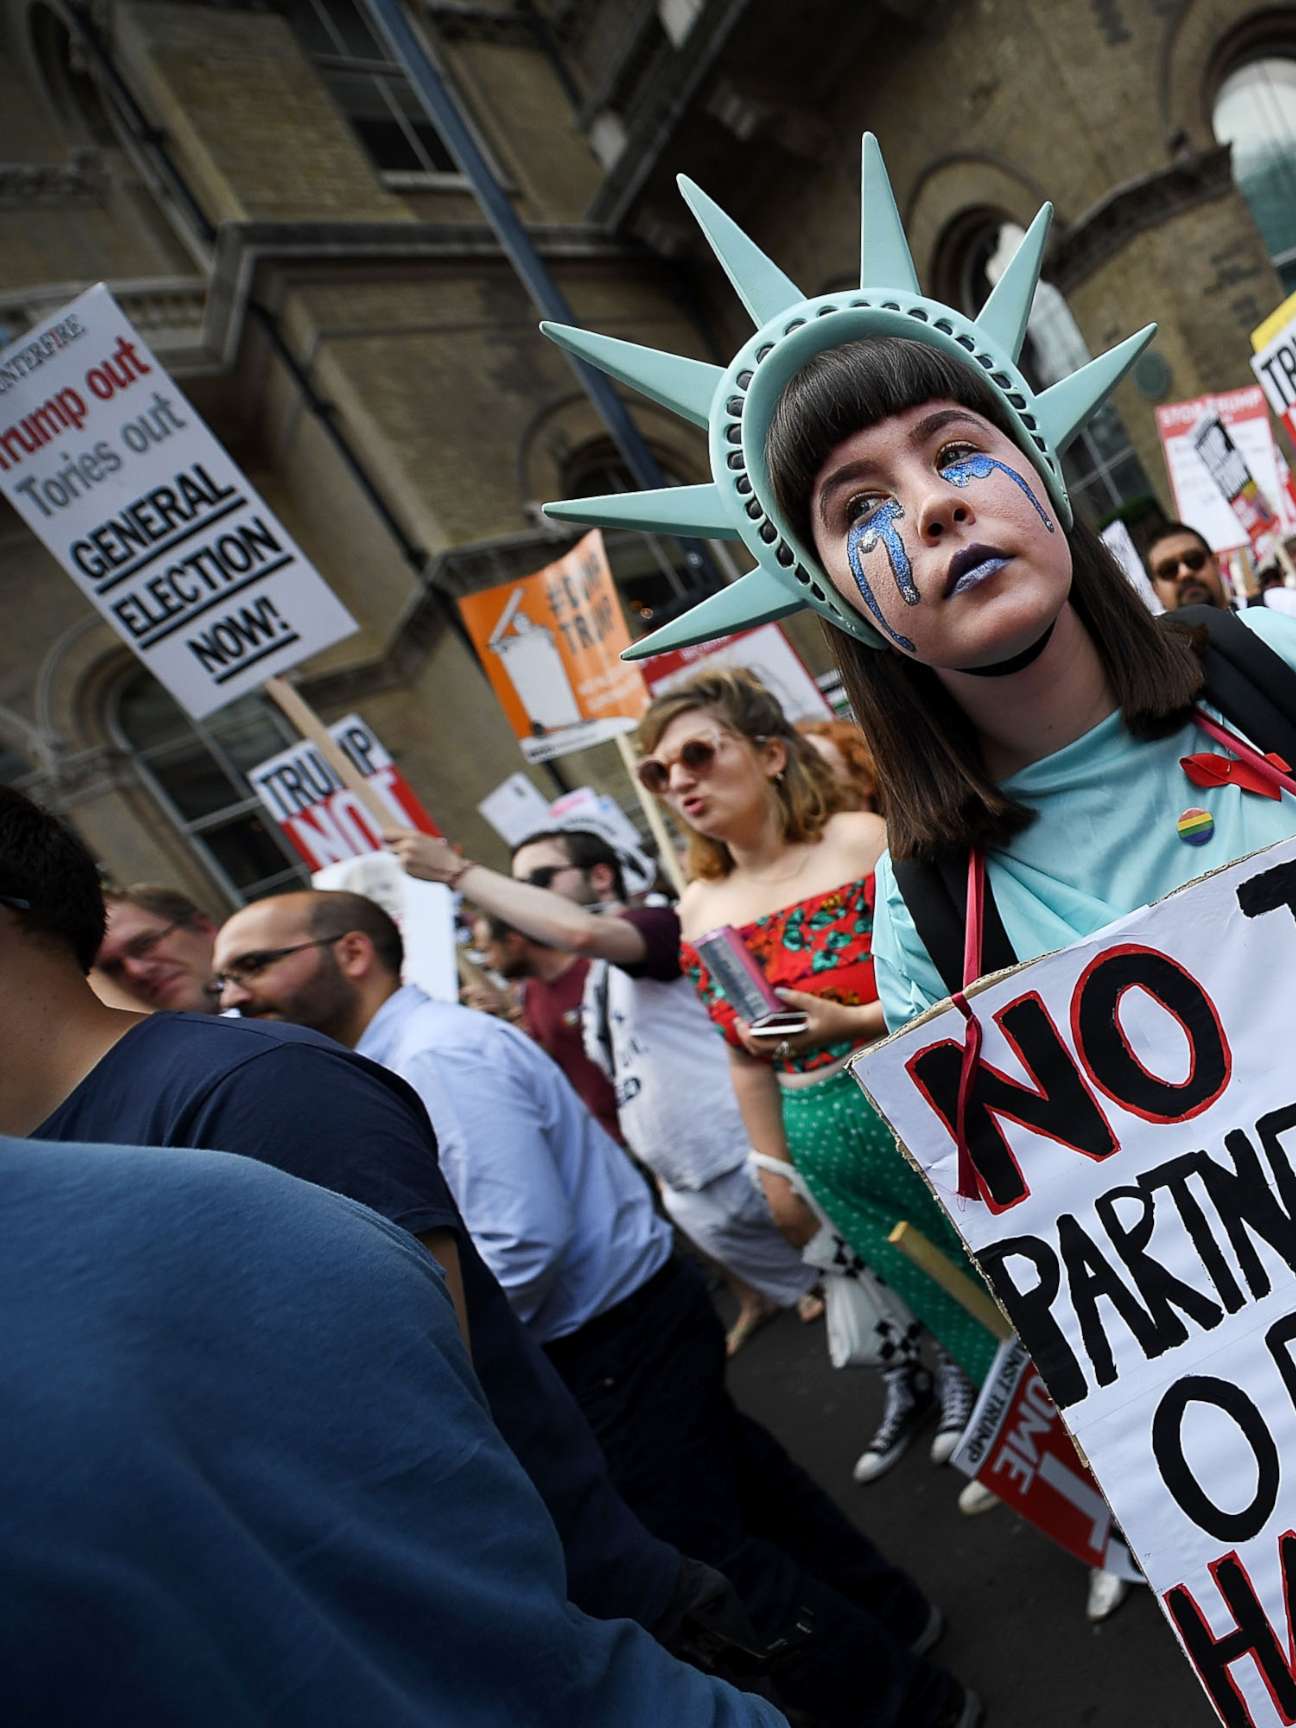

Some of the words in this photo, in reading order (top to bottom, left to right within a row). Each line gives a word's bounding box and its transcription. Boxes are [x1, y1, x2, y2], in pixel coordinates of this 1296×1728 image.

[86, 334, 152, 400] out
[16, 440, 122, 520] Tories
[121, 392, 188, 454] out
[70, 463, 237, 579] GENERAL
[110, 516, 284, 639] ELECTION
[187, 595, 290, 673] NOW!
[906, 943, 1232, 1214] NO
